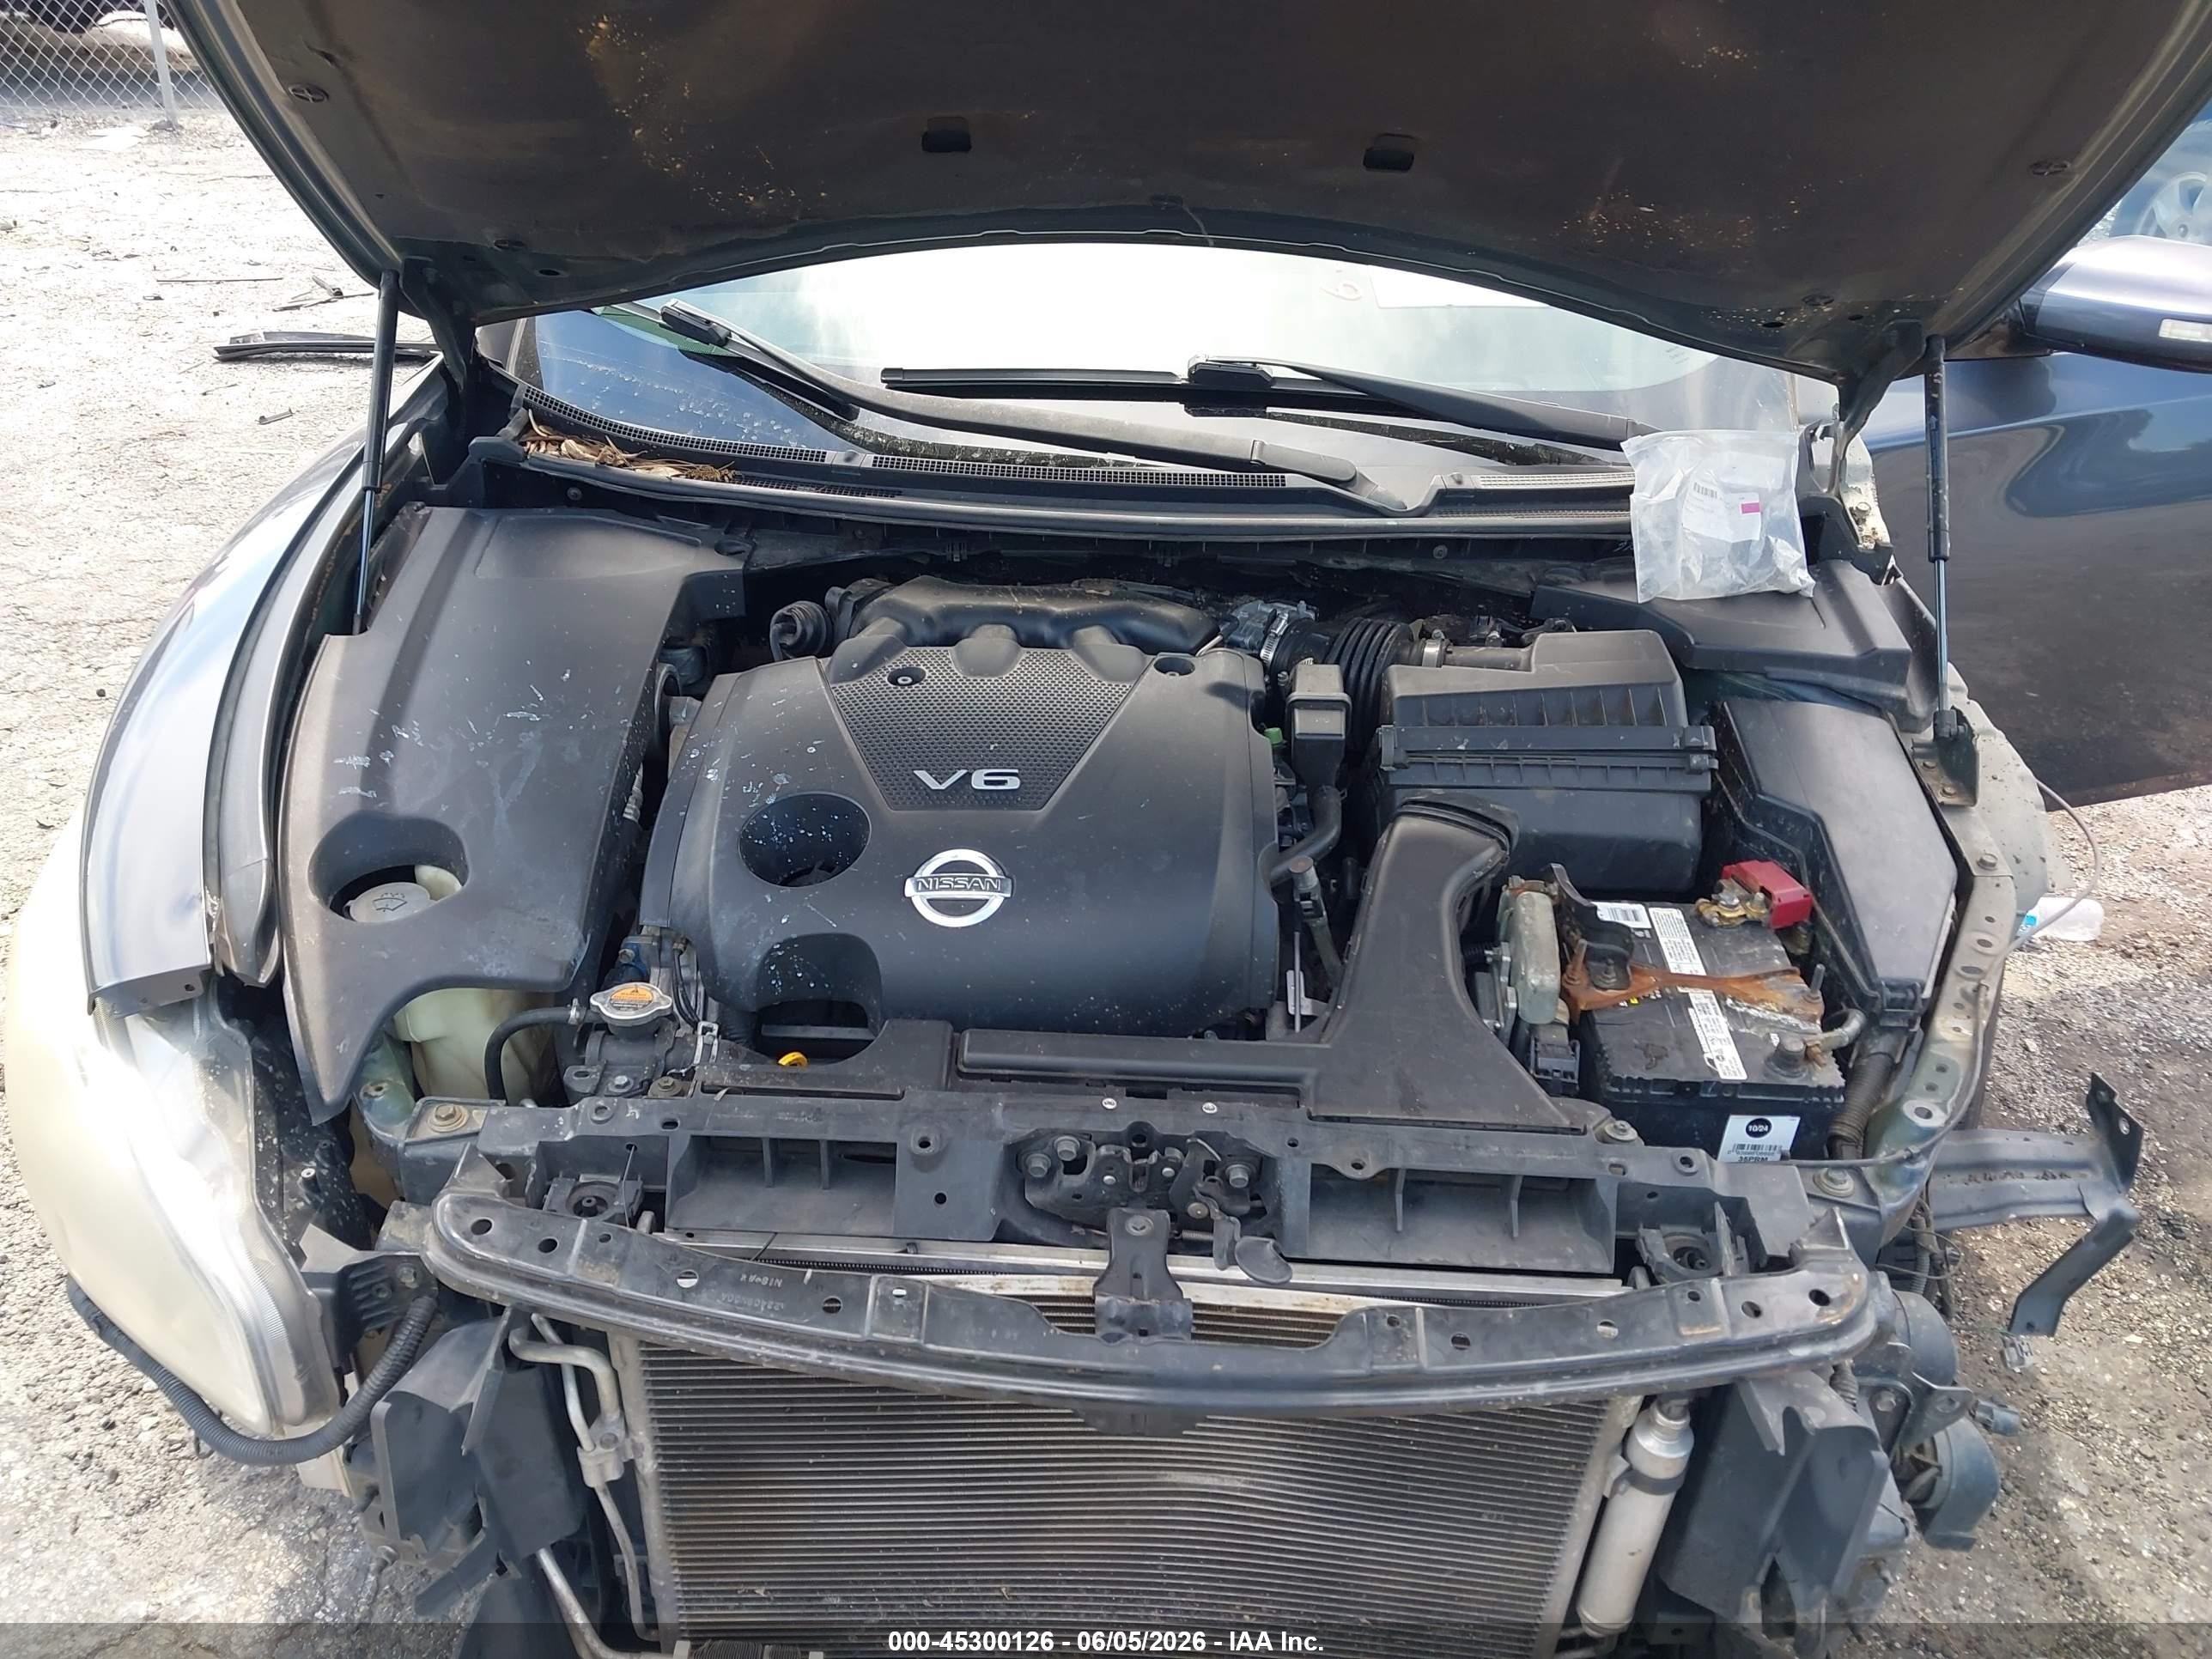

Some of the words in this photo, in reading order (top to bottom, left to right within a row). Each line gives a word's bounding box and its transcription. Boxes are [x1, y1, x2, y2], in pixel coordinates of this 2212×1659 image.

[913, 769, 1021, 790] V6
[917, 877, 1001, 891] NISSAN
[1747, 1124, 1769, 1133] 10/24
